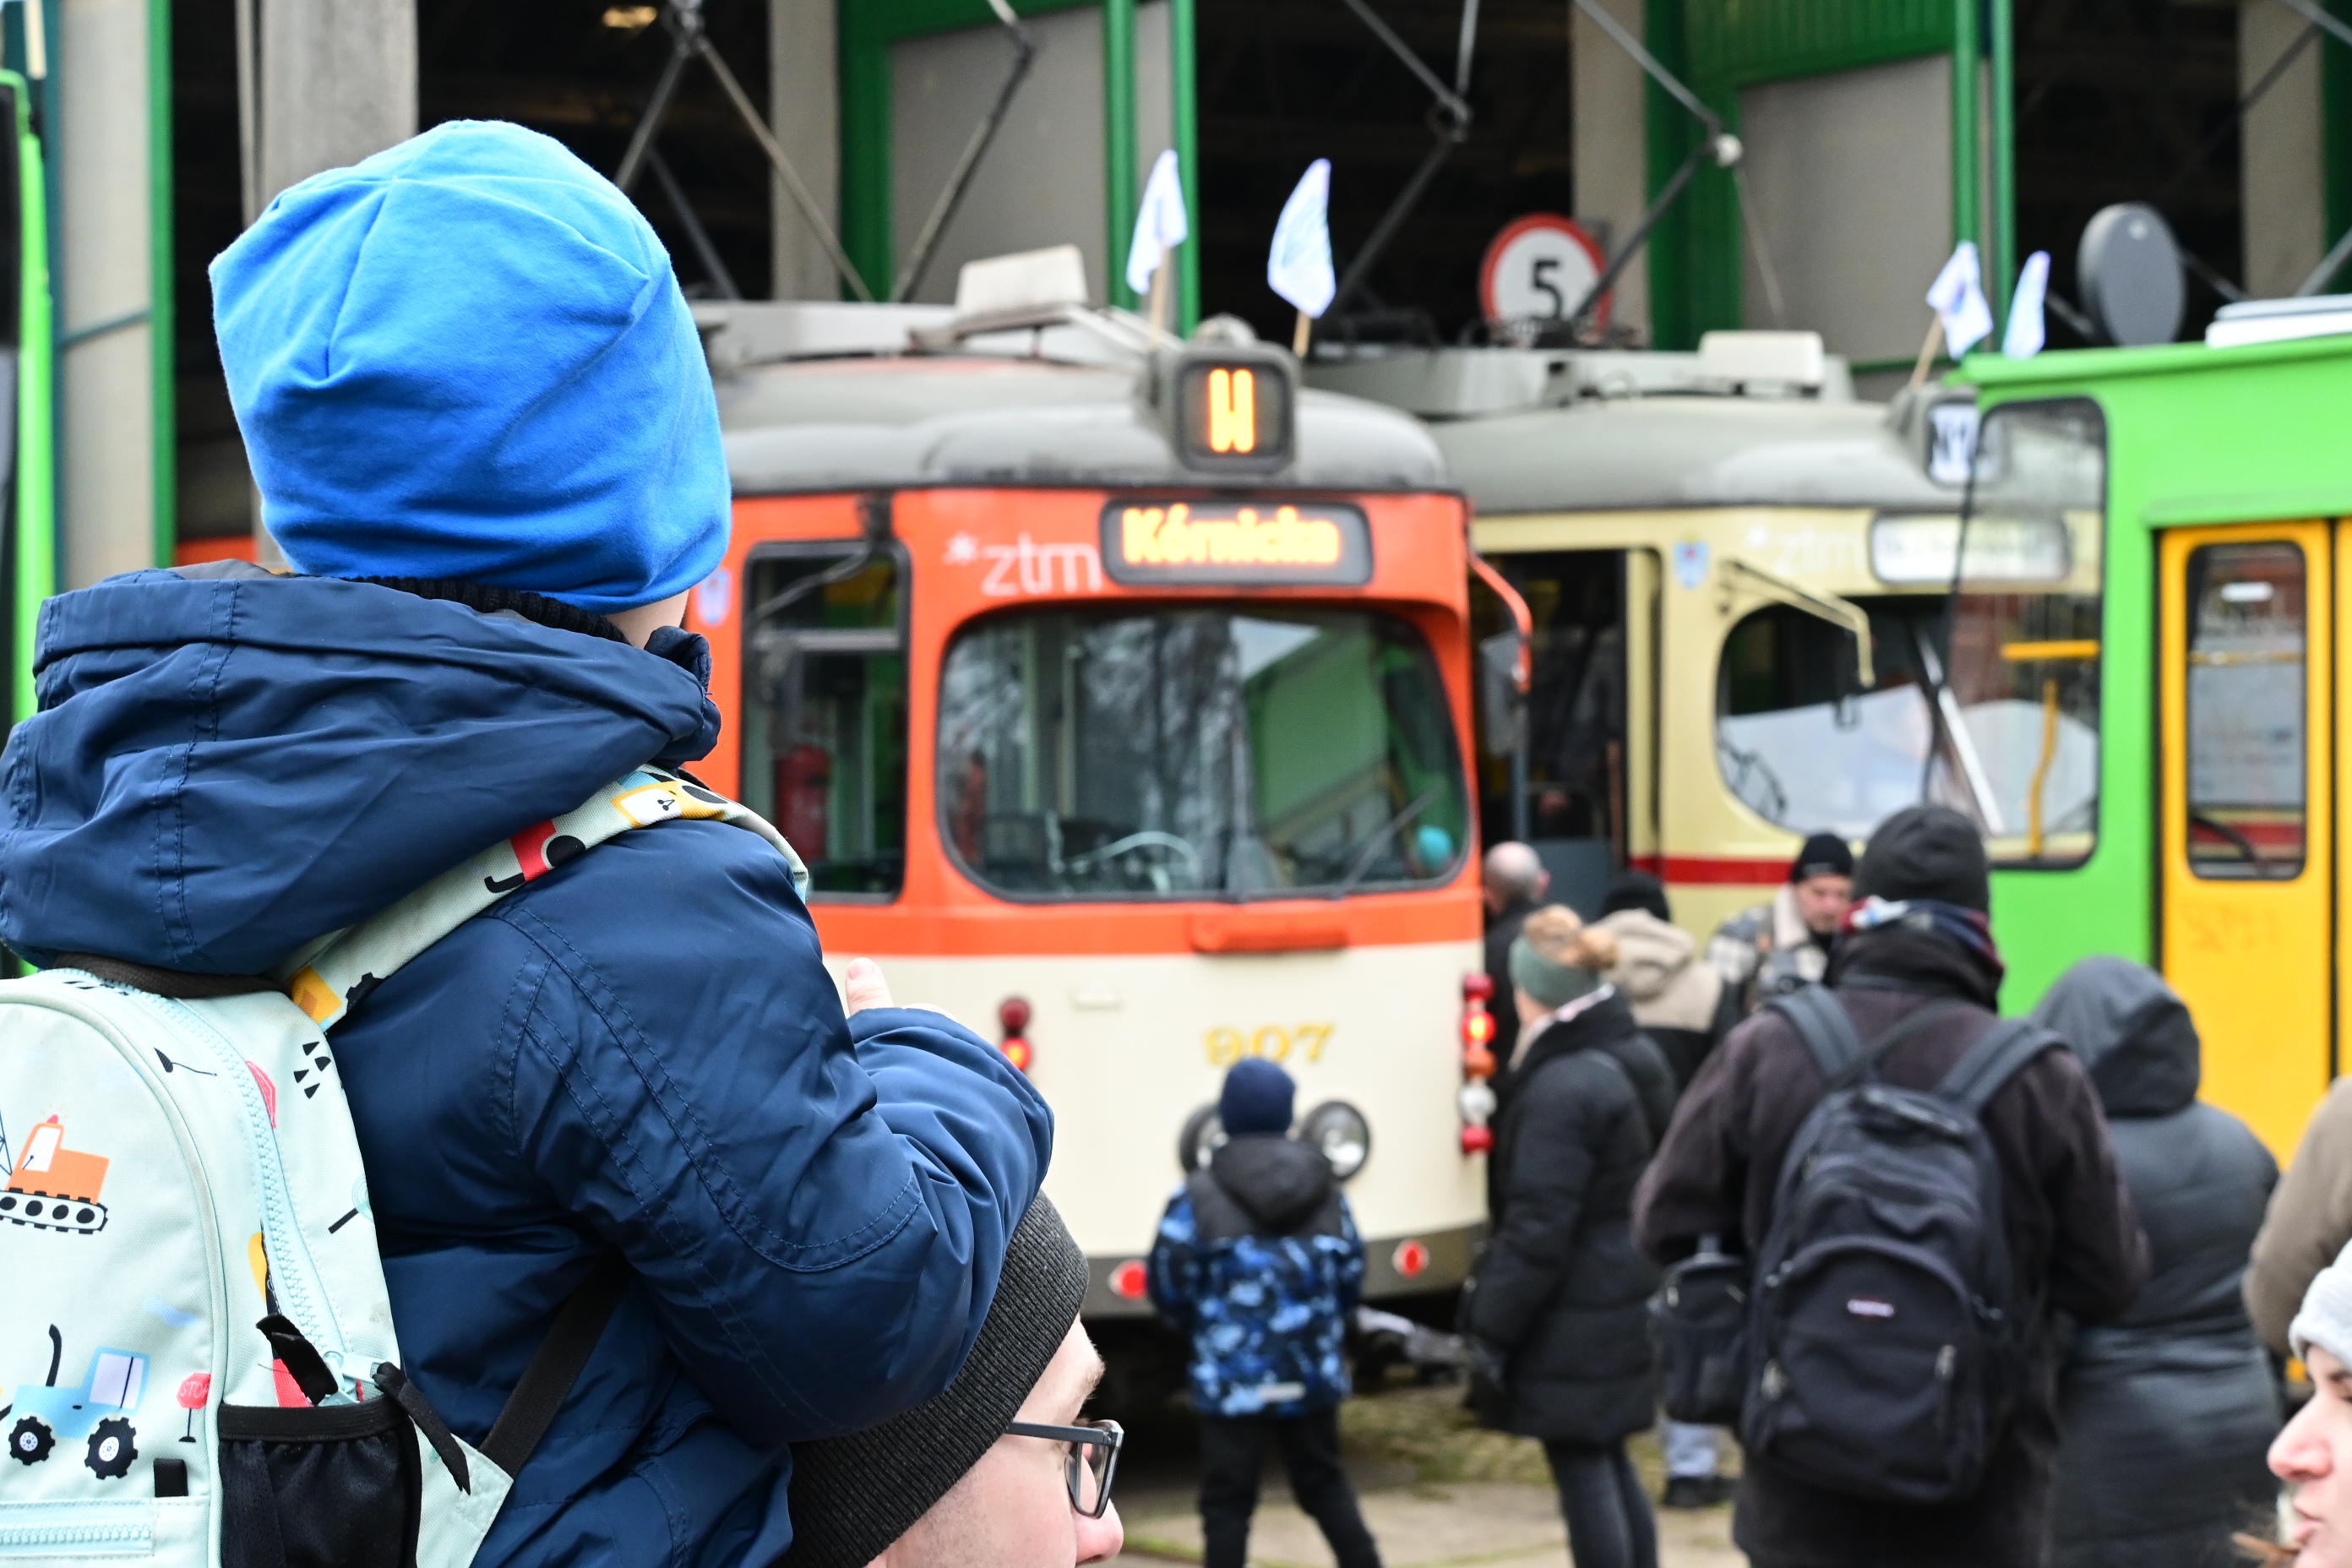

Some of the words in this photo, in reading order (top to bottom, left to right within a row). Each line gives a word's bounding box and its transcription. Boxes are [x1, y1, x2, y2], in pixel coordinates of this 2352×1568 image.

[1527, 259, 1563, 323] 5
[1208, 369, 1255, 453] W
[980, 531, 1102, 596] ztm
[1203, 1021, 1334, 1067] 907
